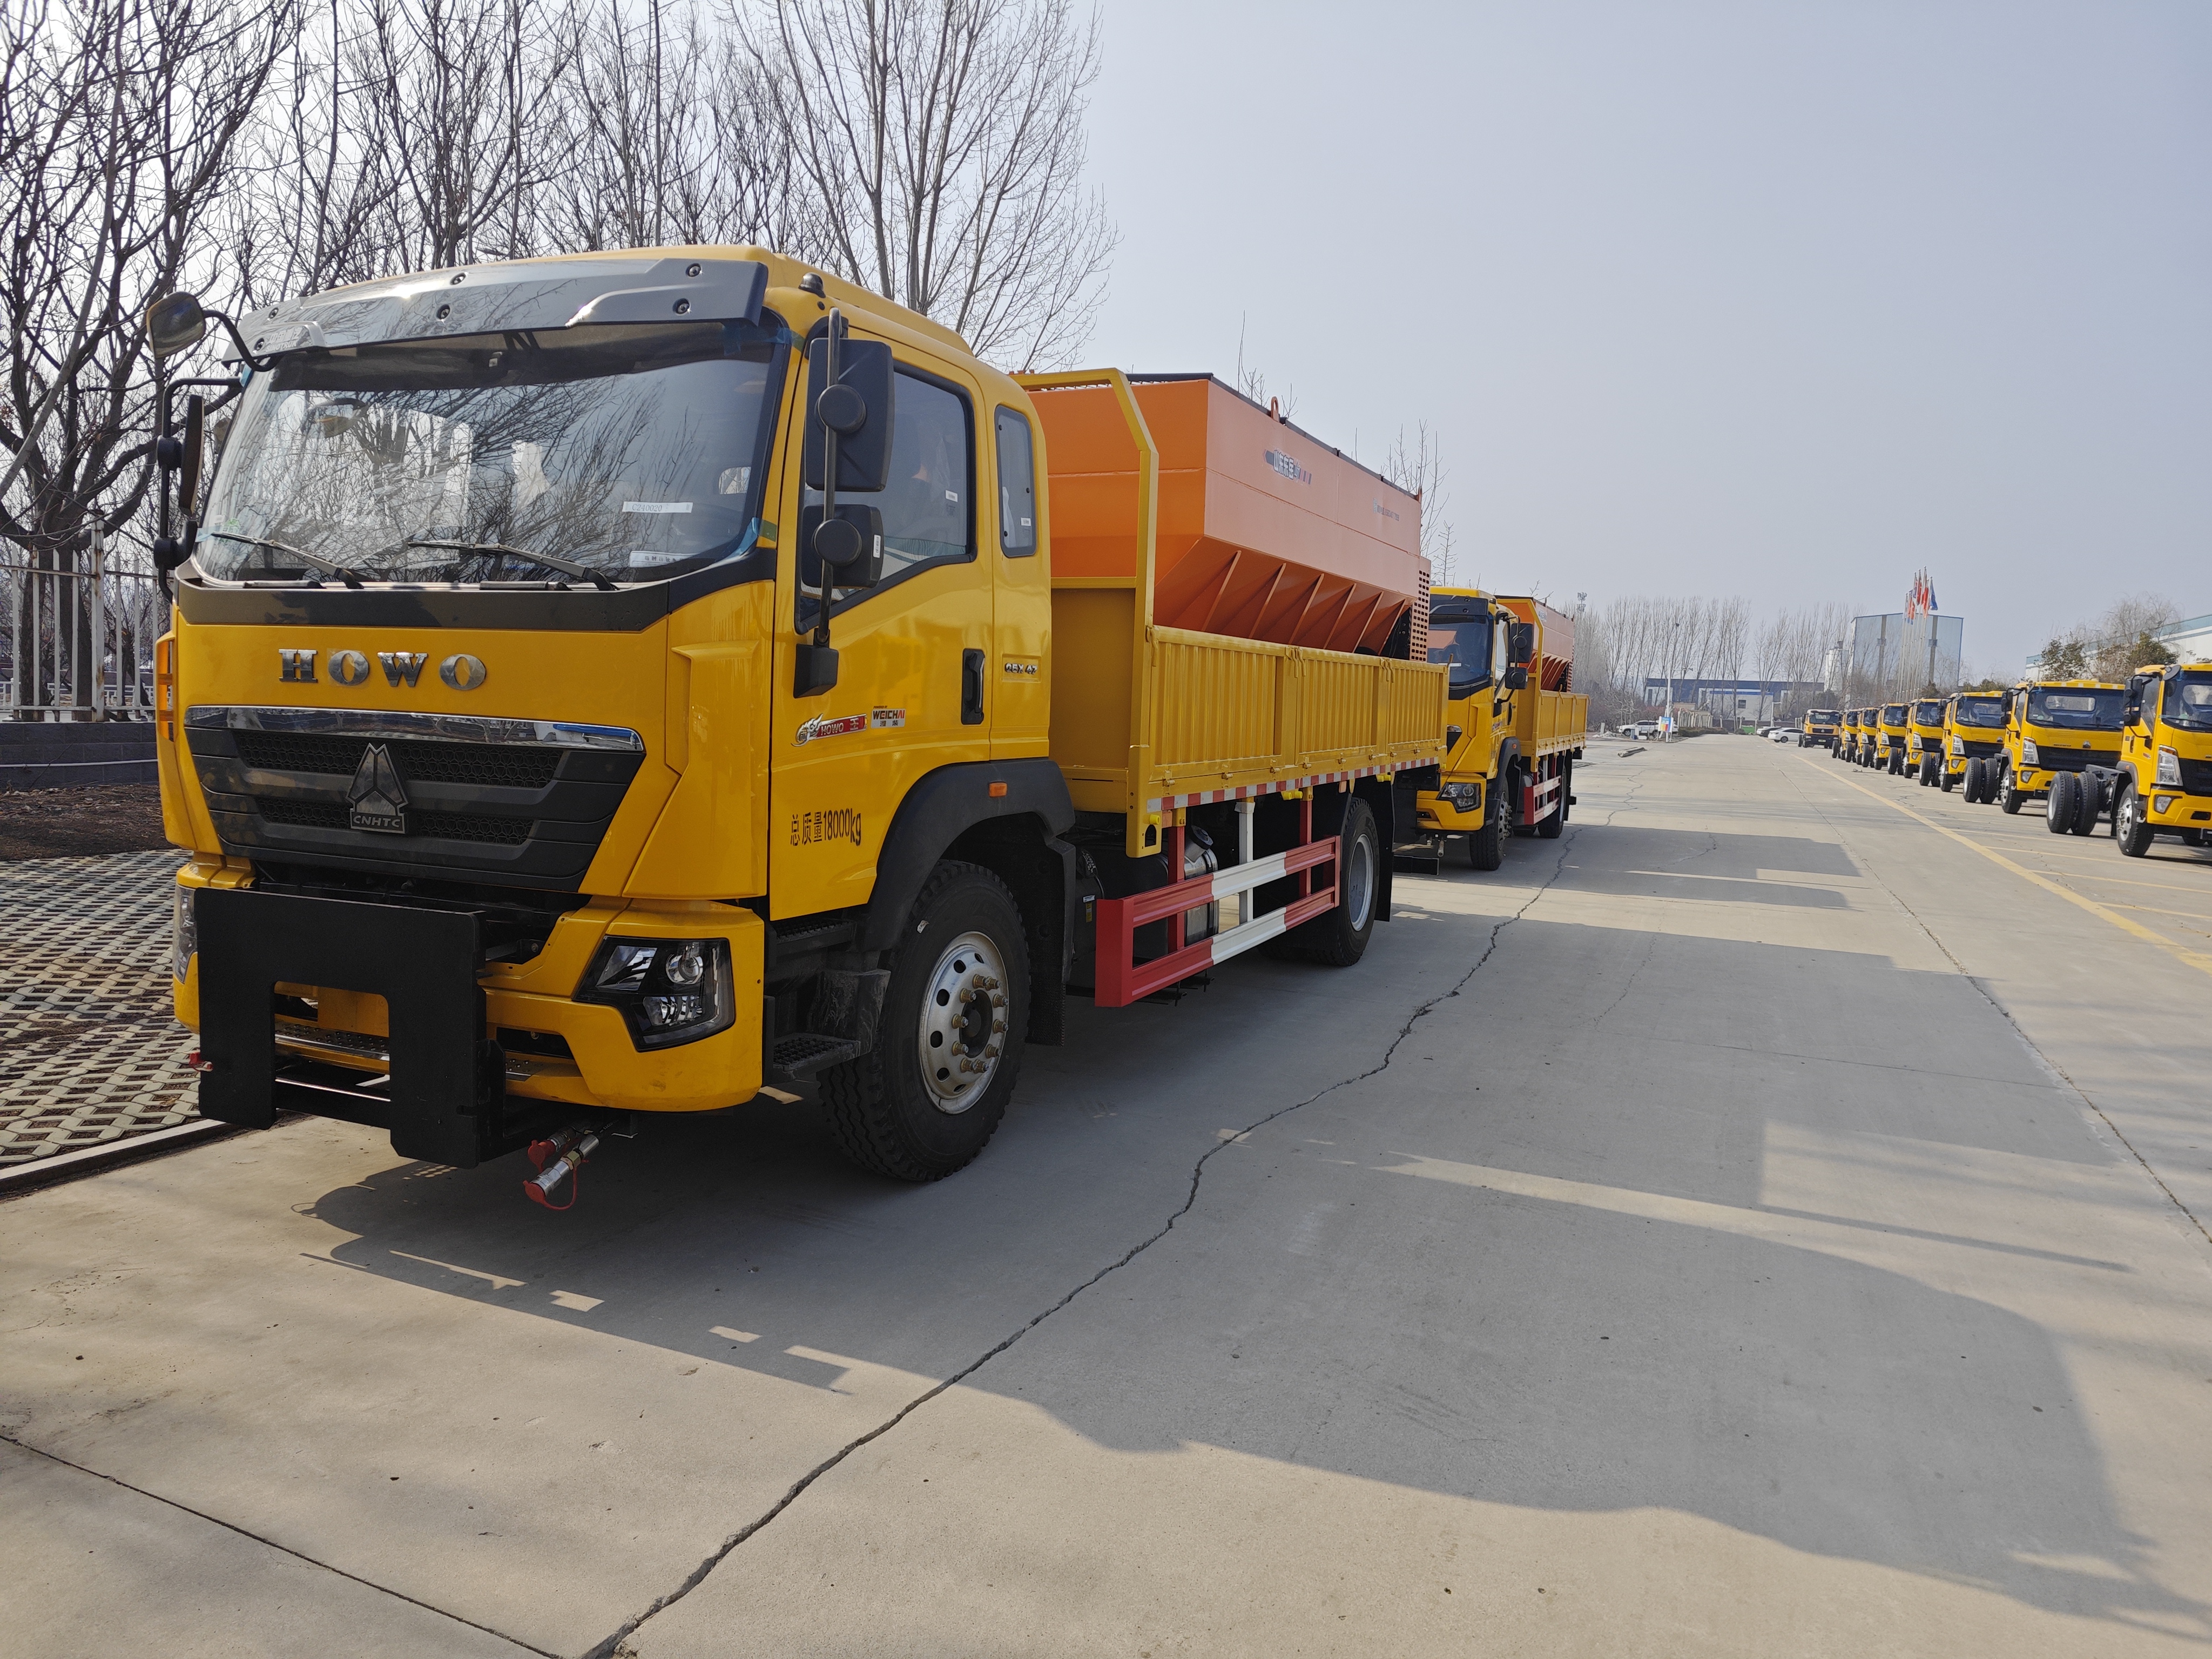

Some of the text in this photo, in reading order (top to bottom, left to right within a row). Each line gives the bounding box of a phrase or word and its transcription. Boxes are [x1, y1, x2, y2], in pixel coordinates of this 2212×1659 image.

[632, 503, 663, 512] C240020
[279, 648, 487, 691] HOWO
[873, 710, 905, 720] WEICHAI
[820, 722, 844, 736] HOWO
[353, 815, 401, 828] CNHTC
[790, 808, 861, 847] 总质量18000kg
